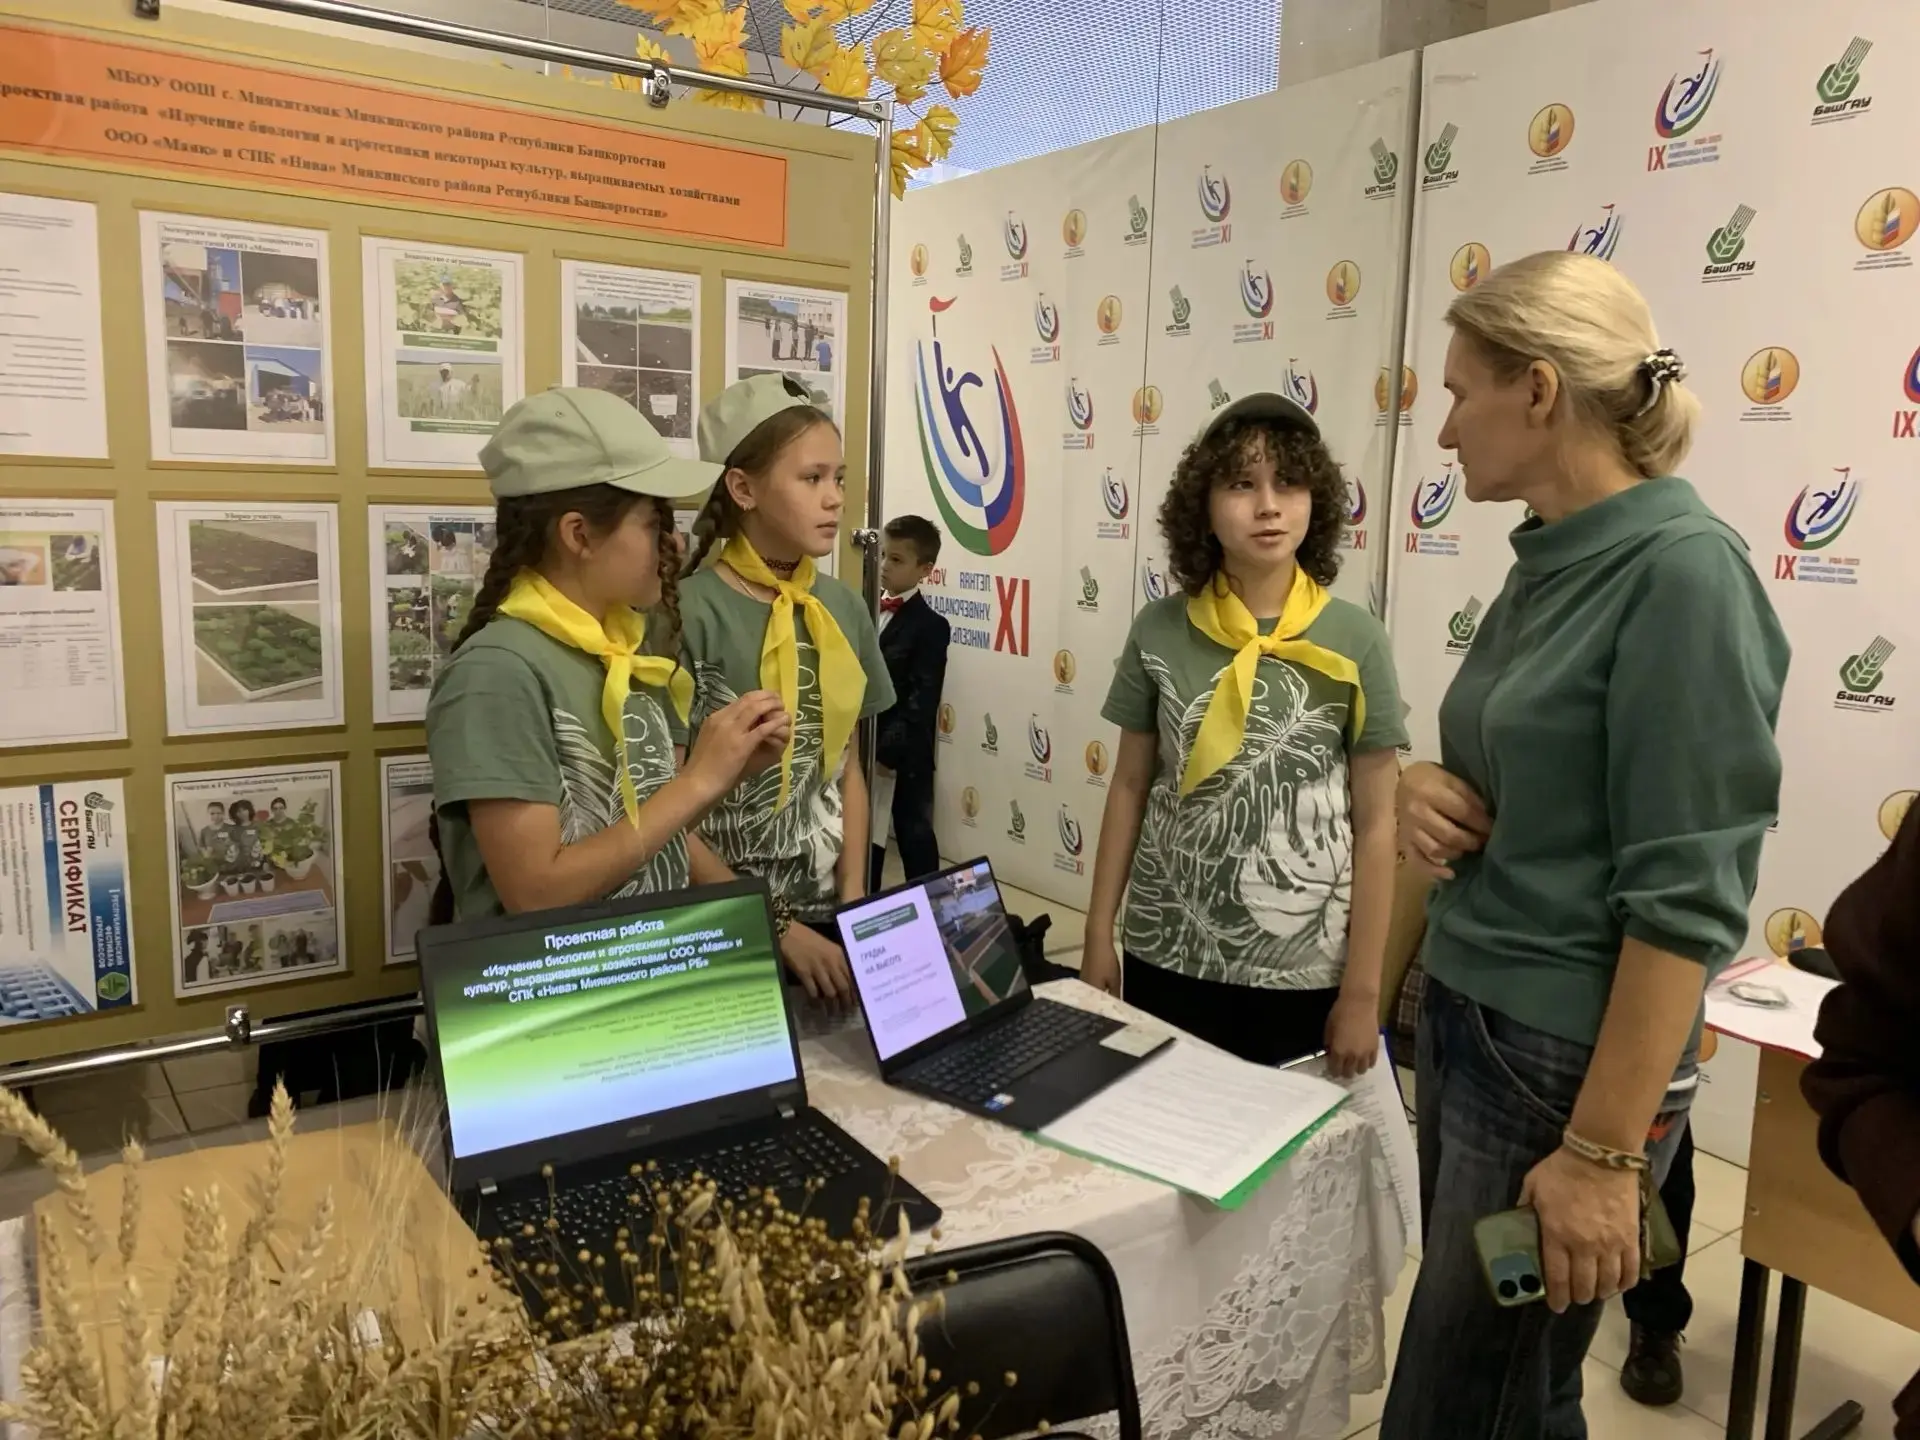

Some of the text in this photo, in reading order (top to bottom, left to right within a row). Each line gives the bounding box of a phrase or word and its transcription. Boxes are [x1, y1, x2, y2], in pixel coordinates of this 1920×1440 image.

[106, 67, 163, 88] МБОУ
[169, 79, 216, 98] ООШ
[448, 125, 495, 143] района
[499, 130, 574, 154] Республики
[578, 144, 666, 169] Башкортостан
[1814, 96, 1872, 116] БашГАУ
[0, 84, 740, 206] роектная работа «Изучение биологии и агротехники некоторых культур, выращиваемых хозяйствами
[1647, 144, 1667, 172] IX
[105, 128, 148, 147] ООО
[153, 136, 217, 156] «Маяк»
[223, 148, 232, 159] и
[238, 148, 275, 165] СПК
[280, 155, 336, 173] «Нива»
[444, 179, 492, 196] района
[496, 184, 571, 206] Республики
[574, 195, 668, 219] Башкортостан»
[1423, 170, 1459, 184] БашГАУ
[1703, 261, 1756, 275] БашГАУ
[1893, 411, 1917, 438] IX
[1406, 532, 1419, 553] IX
[1775, 555, 1797, 580] IX
[1836, 691, 1895, 706] БашГАУ
[85, 809, 96, 850] БашГАУ
[60, 800, 87, 933] СЕРТИФИКАТ
[96, 915, 106, 969] АГРОКЛАССОВ
[104, 926, 113, 968] ФЕСТИВАЛЬ
[112, 894, 124, 966] РЕСПУБЛИКАНСКИЙ
[544, 920, 665, 950] Проектная работа
[464, 938, 743, 998] культур, выращиваемых хозяйствами ООО «Маяк» и
[483, 929, 724, 977] «Изучение биологии и агротехники некоторых
[508, 988, 534, 1003] СПК
[537, 983, 577, 997] «Нива»
[649, 961, 686, 979] района
[688, 957, 709, 969] РБ»
